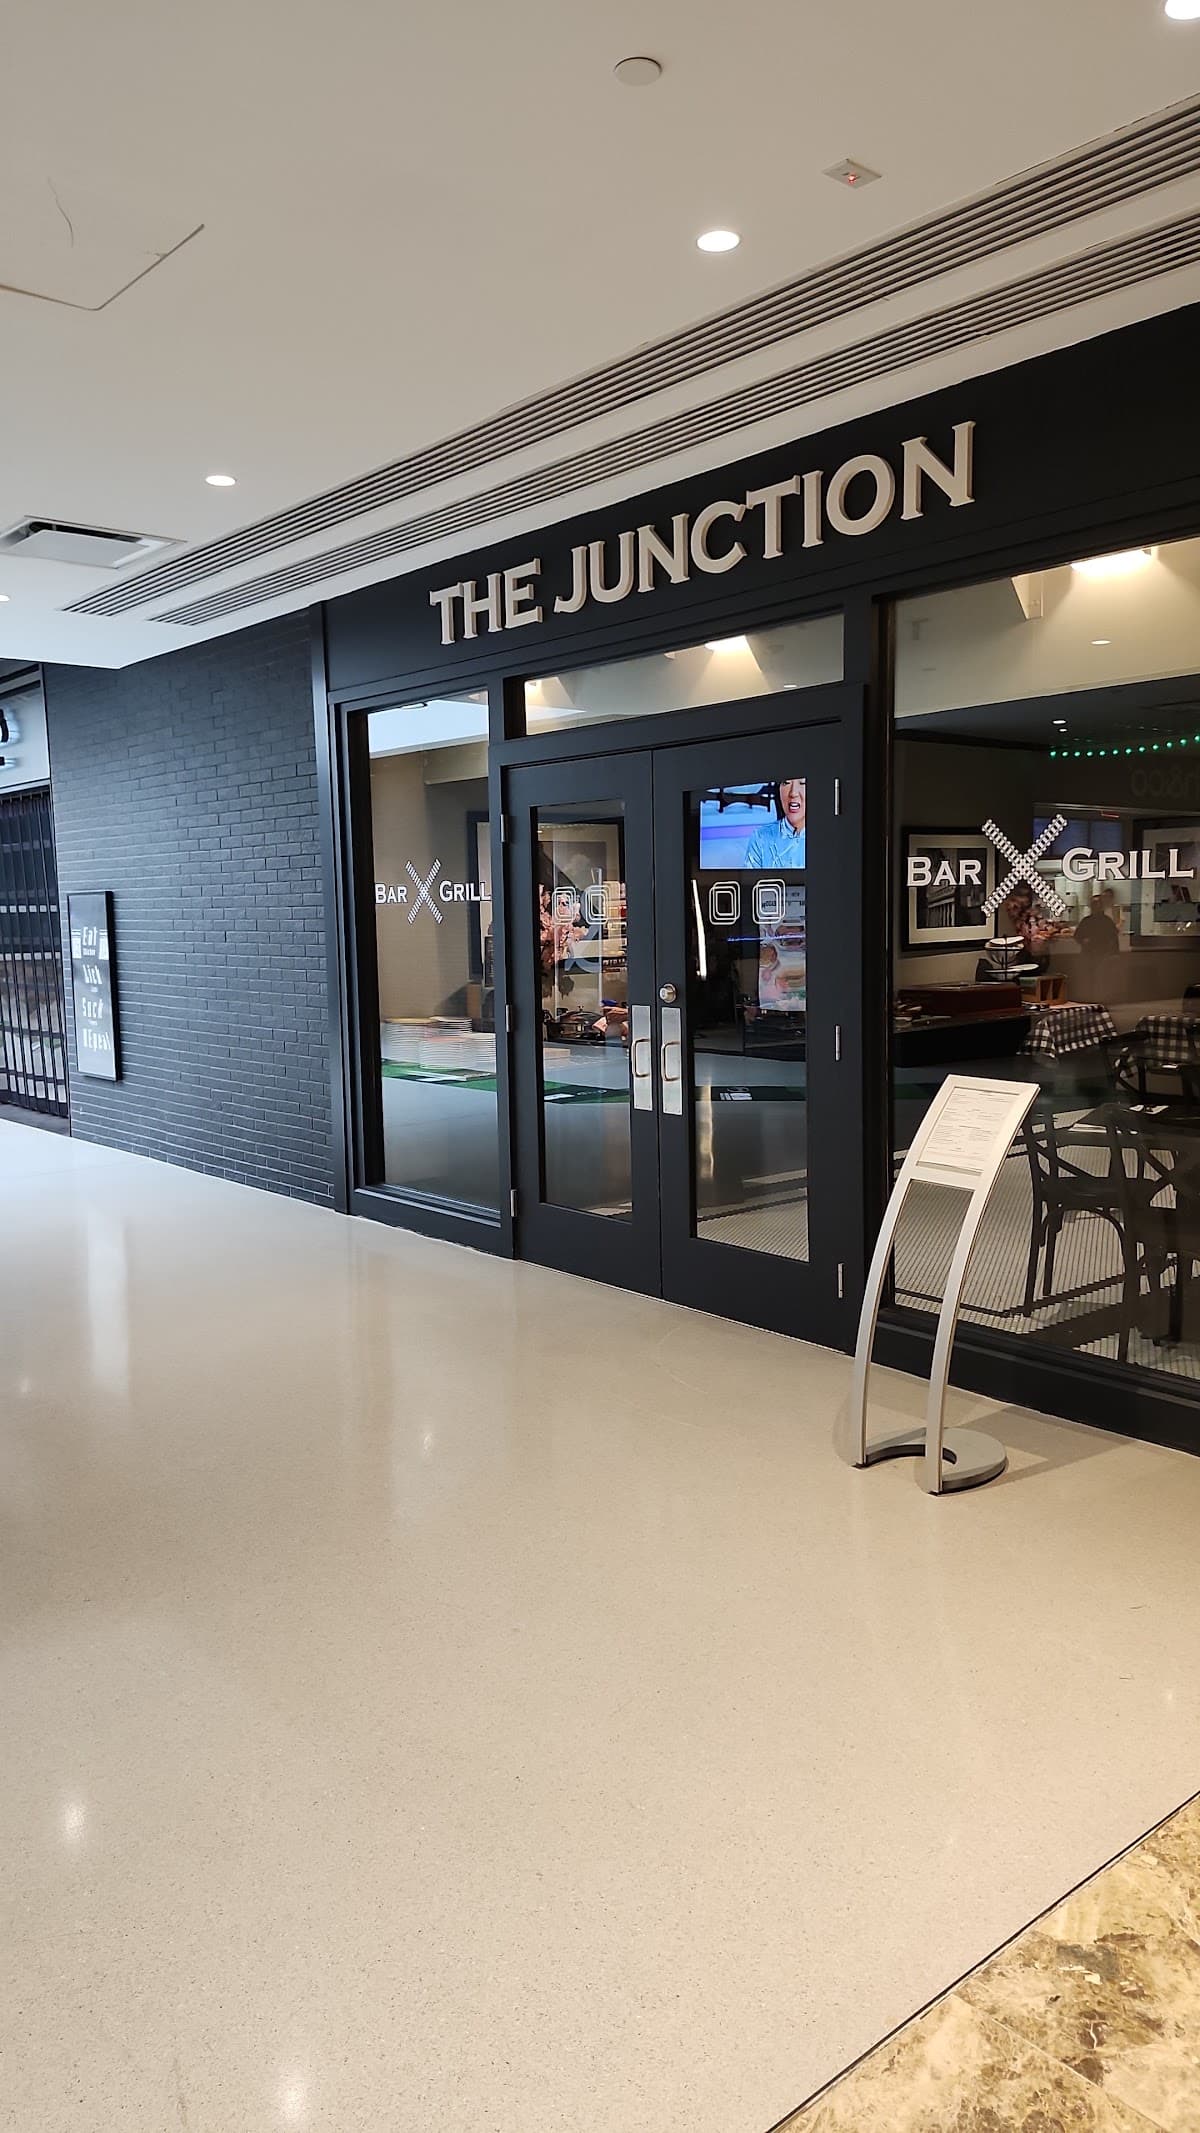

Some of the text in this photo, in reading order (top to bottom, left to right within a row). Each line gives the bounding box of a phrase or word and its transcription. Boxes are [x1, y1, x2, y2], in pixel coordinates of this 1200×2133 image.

[429, 421, 976, 645] THE JUNCTION
[906, 856, 982, 887] BAR
[1061, 847, 1194, 882] GRILL
[375, 883, 408, 904] BAR
[439, 880, 492, 902] GRILL
[82, 926, 98, 946] Eat
